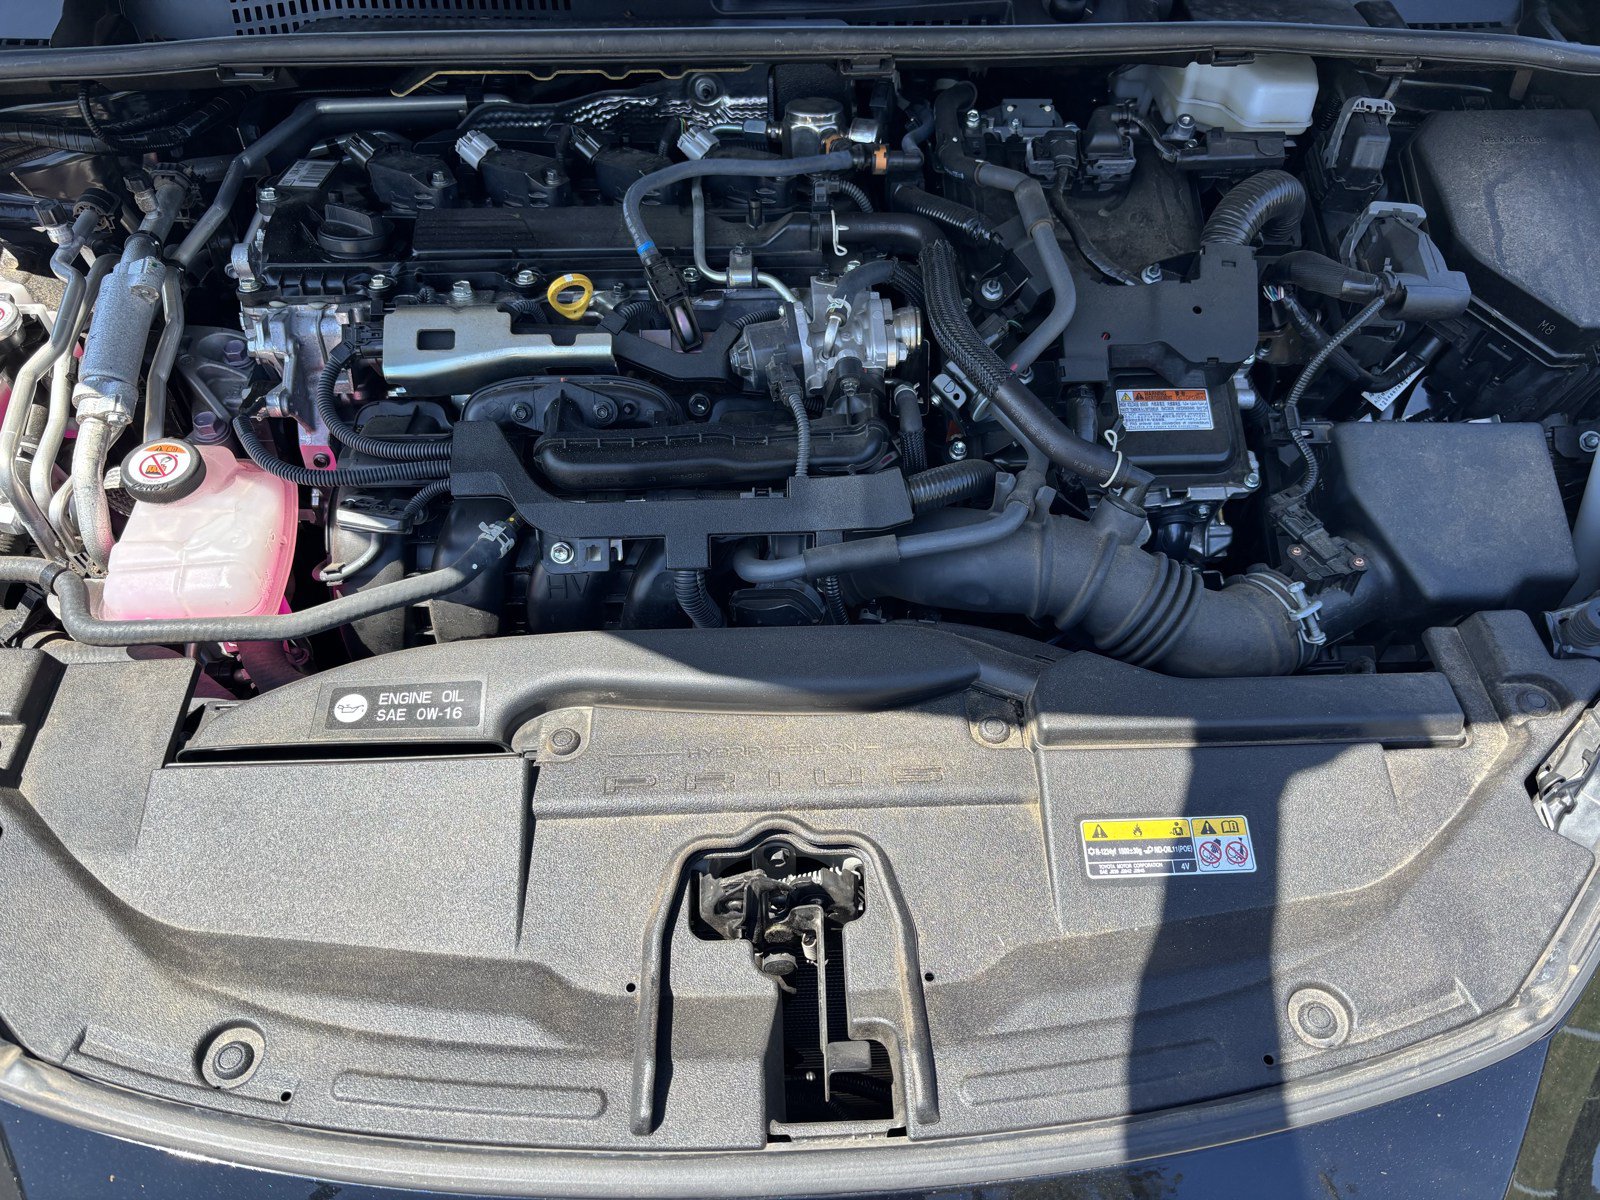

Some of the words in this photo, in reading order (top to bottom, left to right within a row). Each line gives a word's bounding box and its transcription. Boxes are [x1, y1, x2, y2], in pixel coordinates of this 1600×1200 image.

[1537, 319, 1556, 335] M8
[546, 574, 590, 600] HV
[378, 691, 432, 705] ENGINE
[441, 689, 465, 703] OIL
[376, 708, 407, 721] SAE
[416, 706, 463, 720] 0W-16
[603, 765, 944, 794] PRIUS
[1181, 862, 1190, 870] 4V
